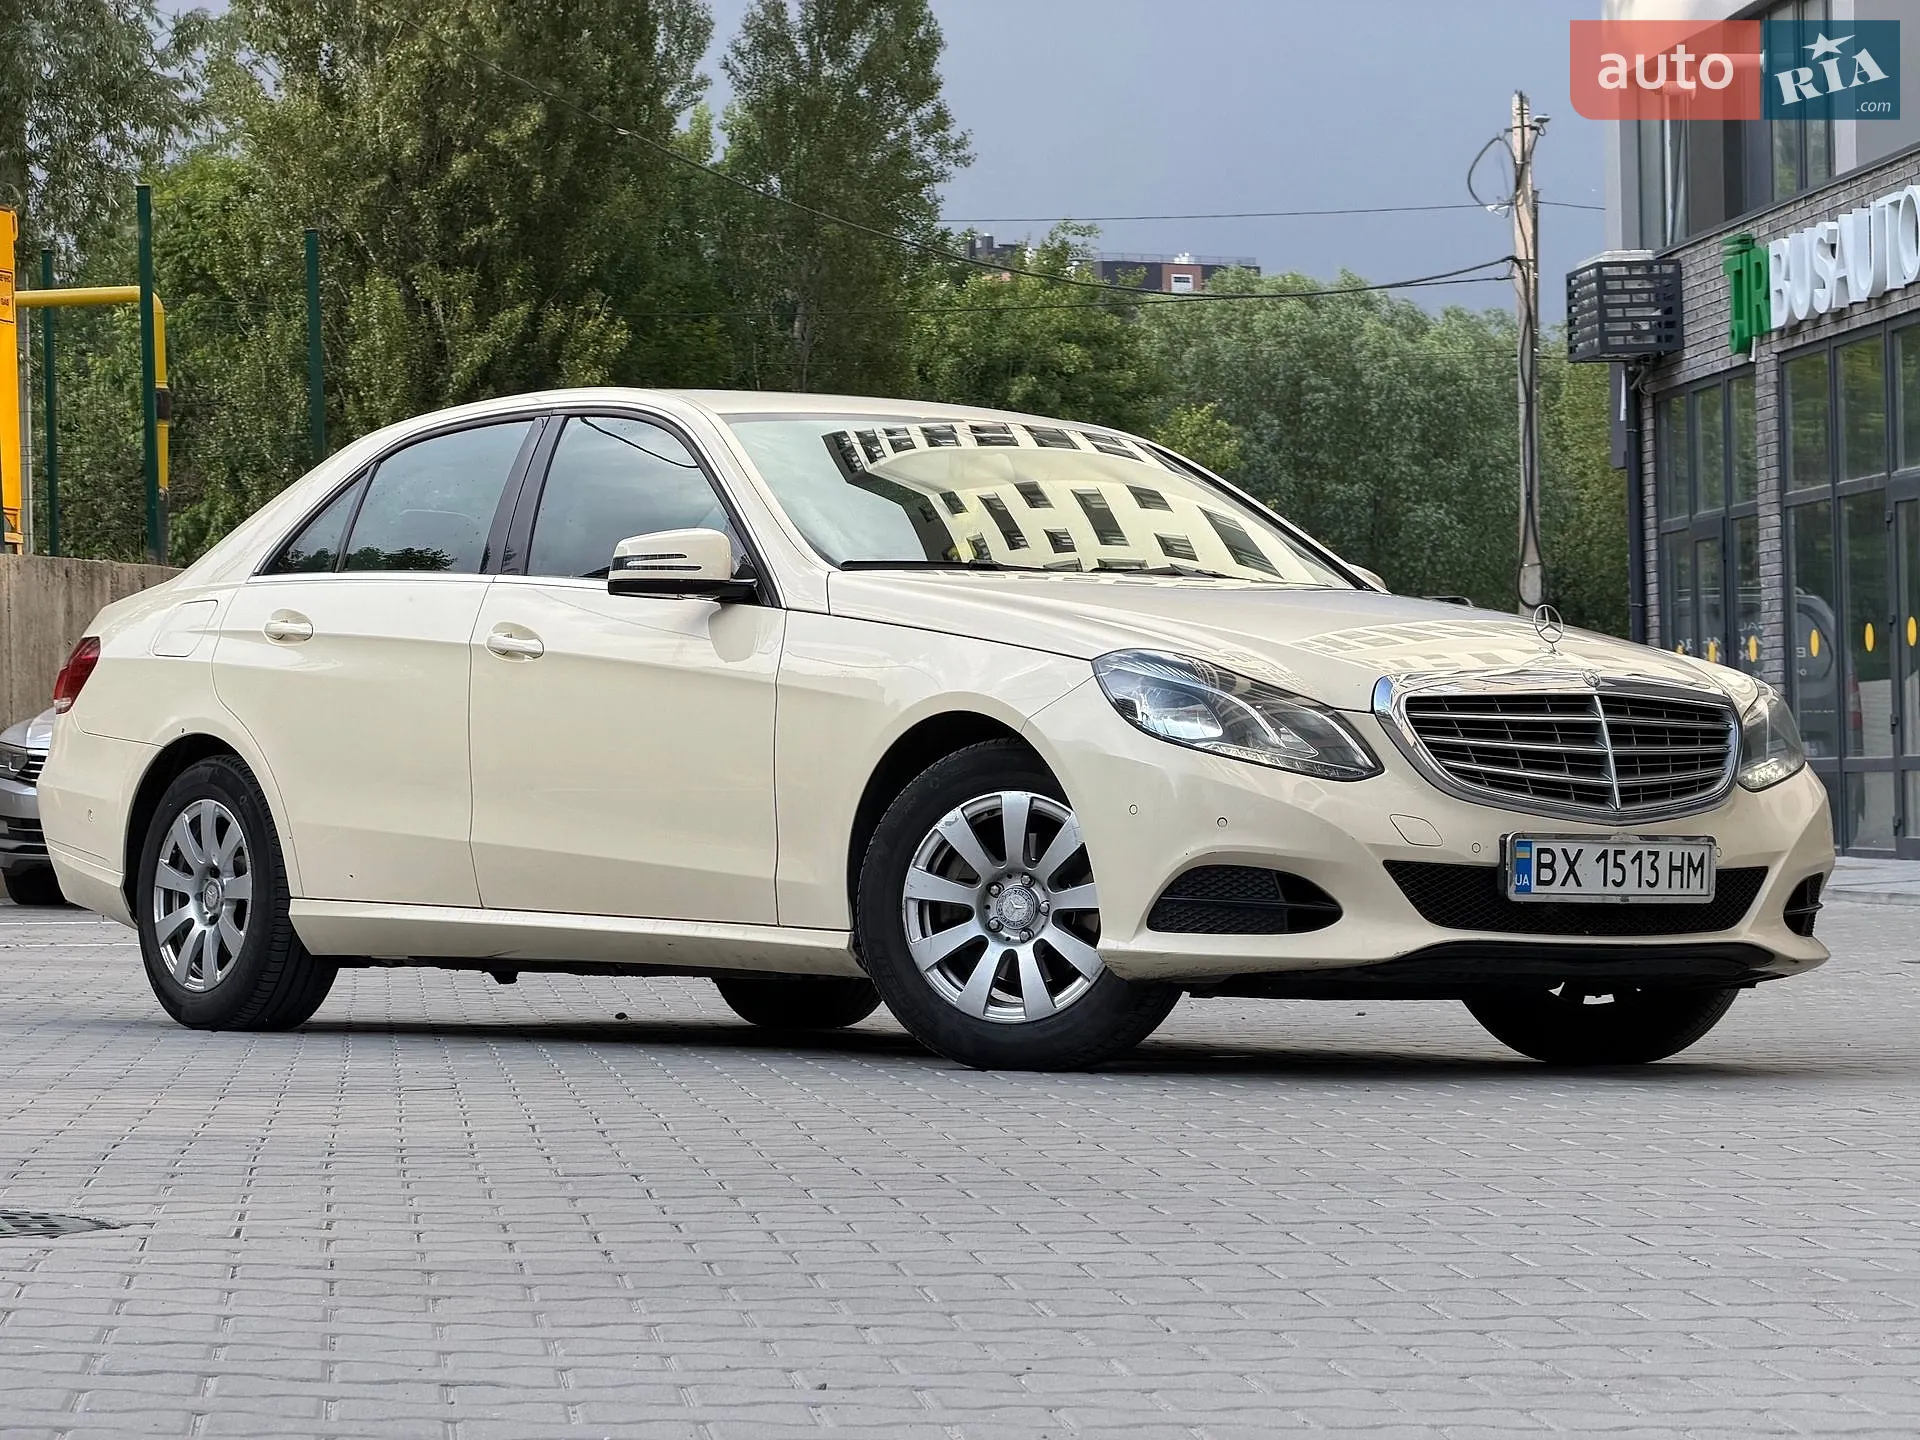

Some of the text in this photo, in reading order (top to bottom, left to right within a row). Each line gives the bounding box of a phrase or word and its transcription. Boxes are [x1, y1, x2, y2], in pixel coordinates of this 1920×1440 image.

[1515, 873, 1530, 887] UA
[1535, 847, 1706, 889] BX 1513 HM
